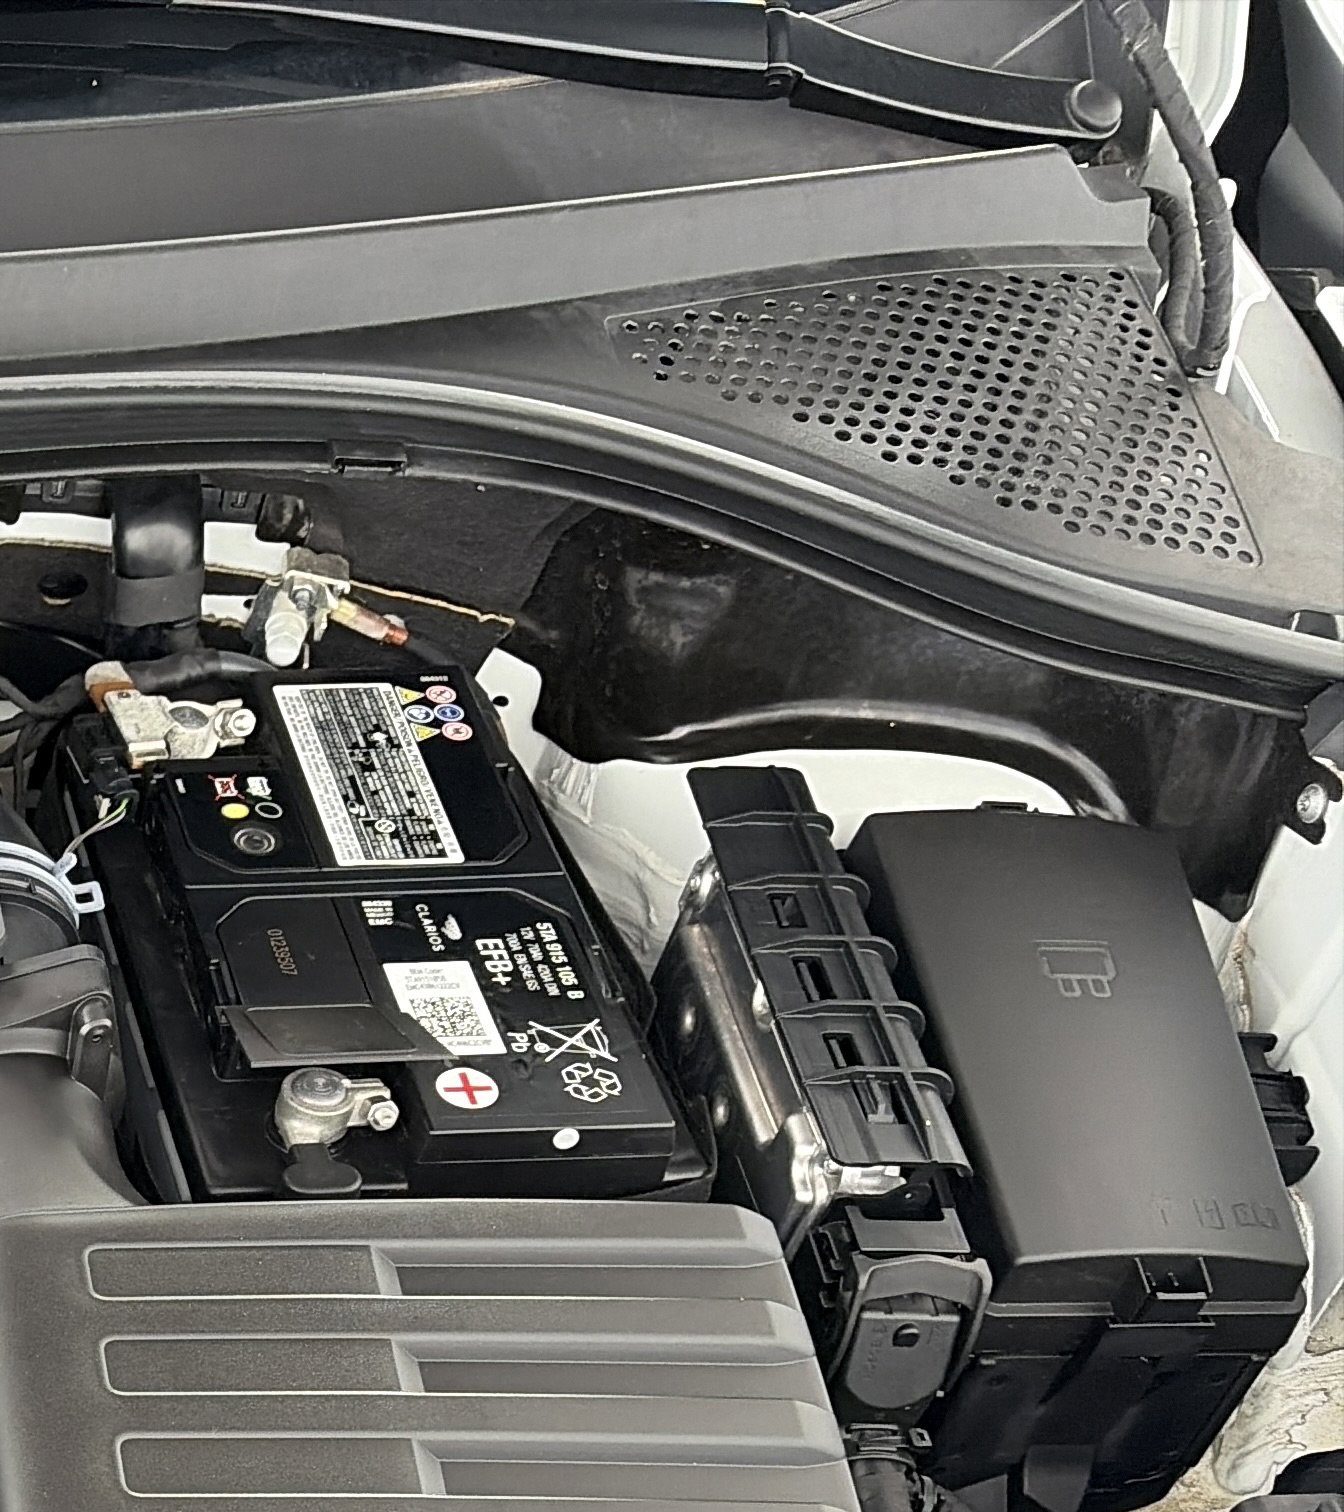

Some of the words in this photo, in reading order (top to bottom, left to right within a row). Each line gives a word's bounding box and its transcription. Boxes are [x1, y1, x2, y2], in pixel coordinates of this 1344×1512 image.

[415, 903, 446, 952] CLARIOS
[520, 926, 536, 940] 12V
[536, 922, 558, 942] 5TA
[267, 929, 298, 975] 01239507
[475, 938, 514, 986] EFB+
[545, 943, 568, 963] 915
[518, 964, 536, 980] SAE
[555, 965, 579, 986] 105
[507, 1032, 529, 1053] Pb
